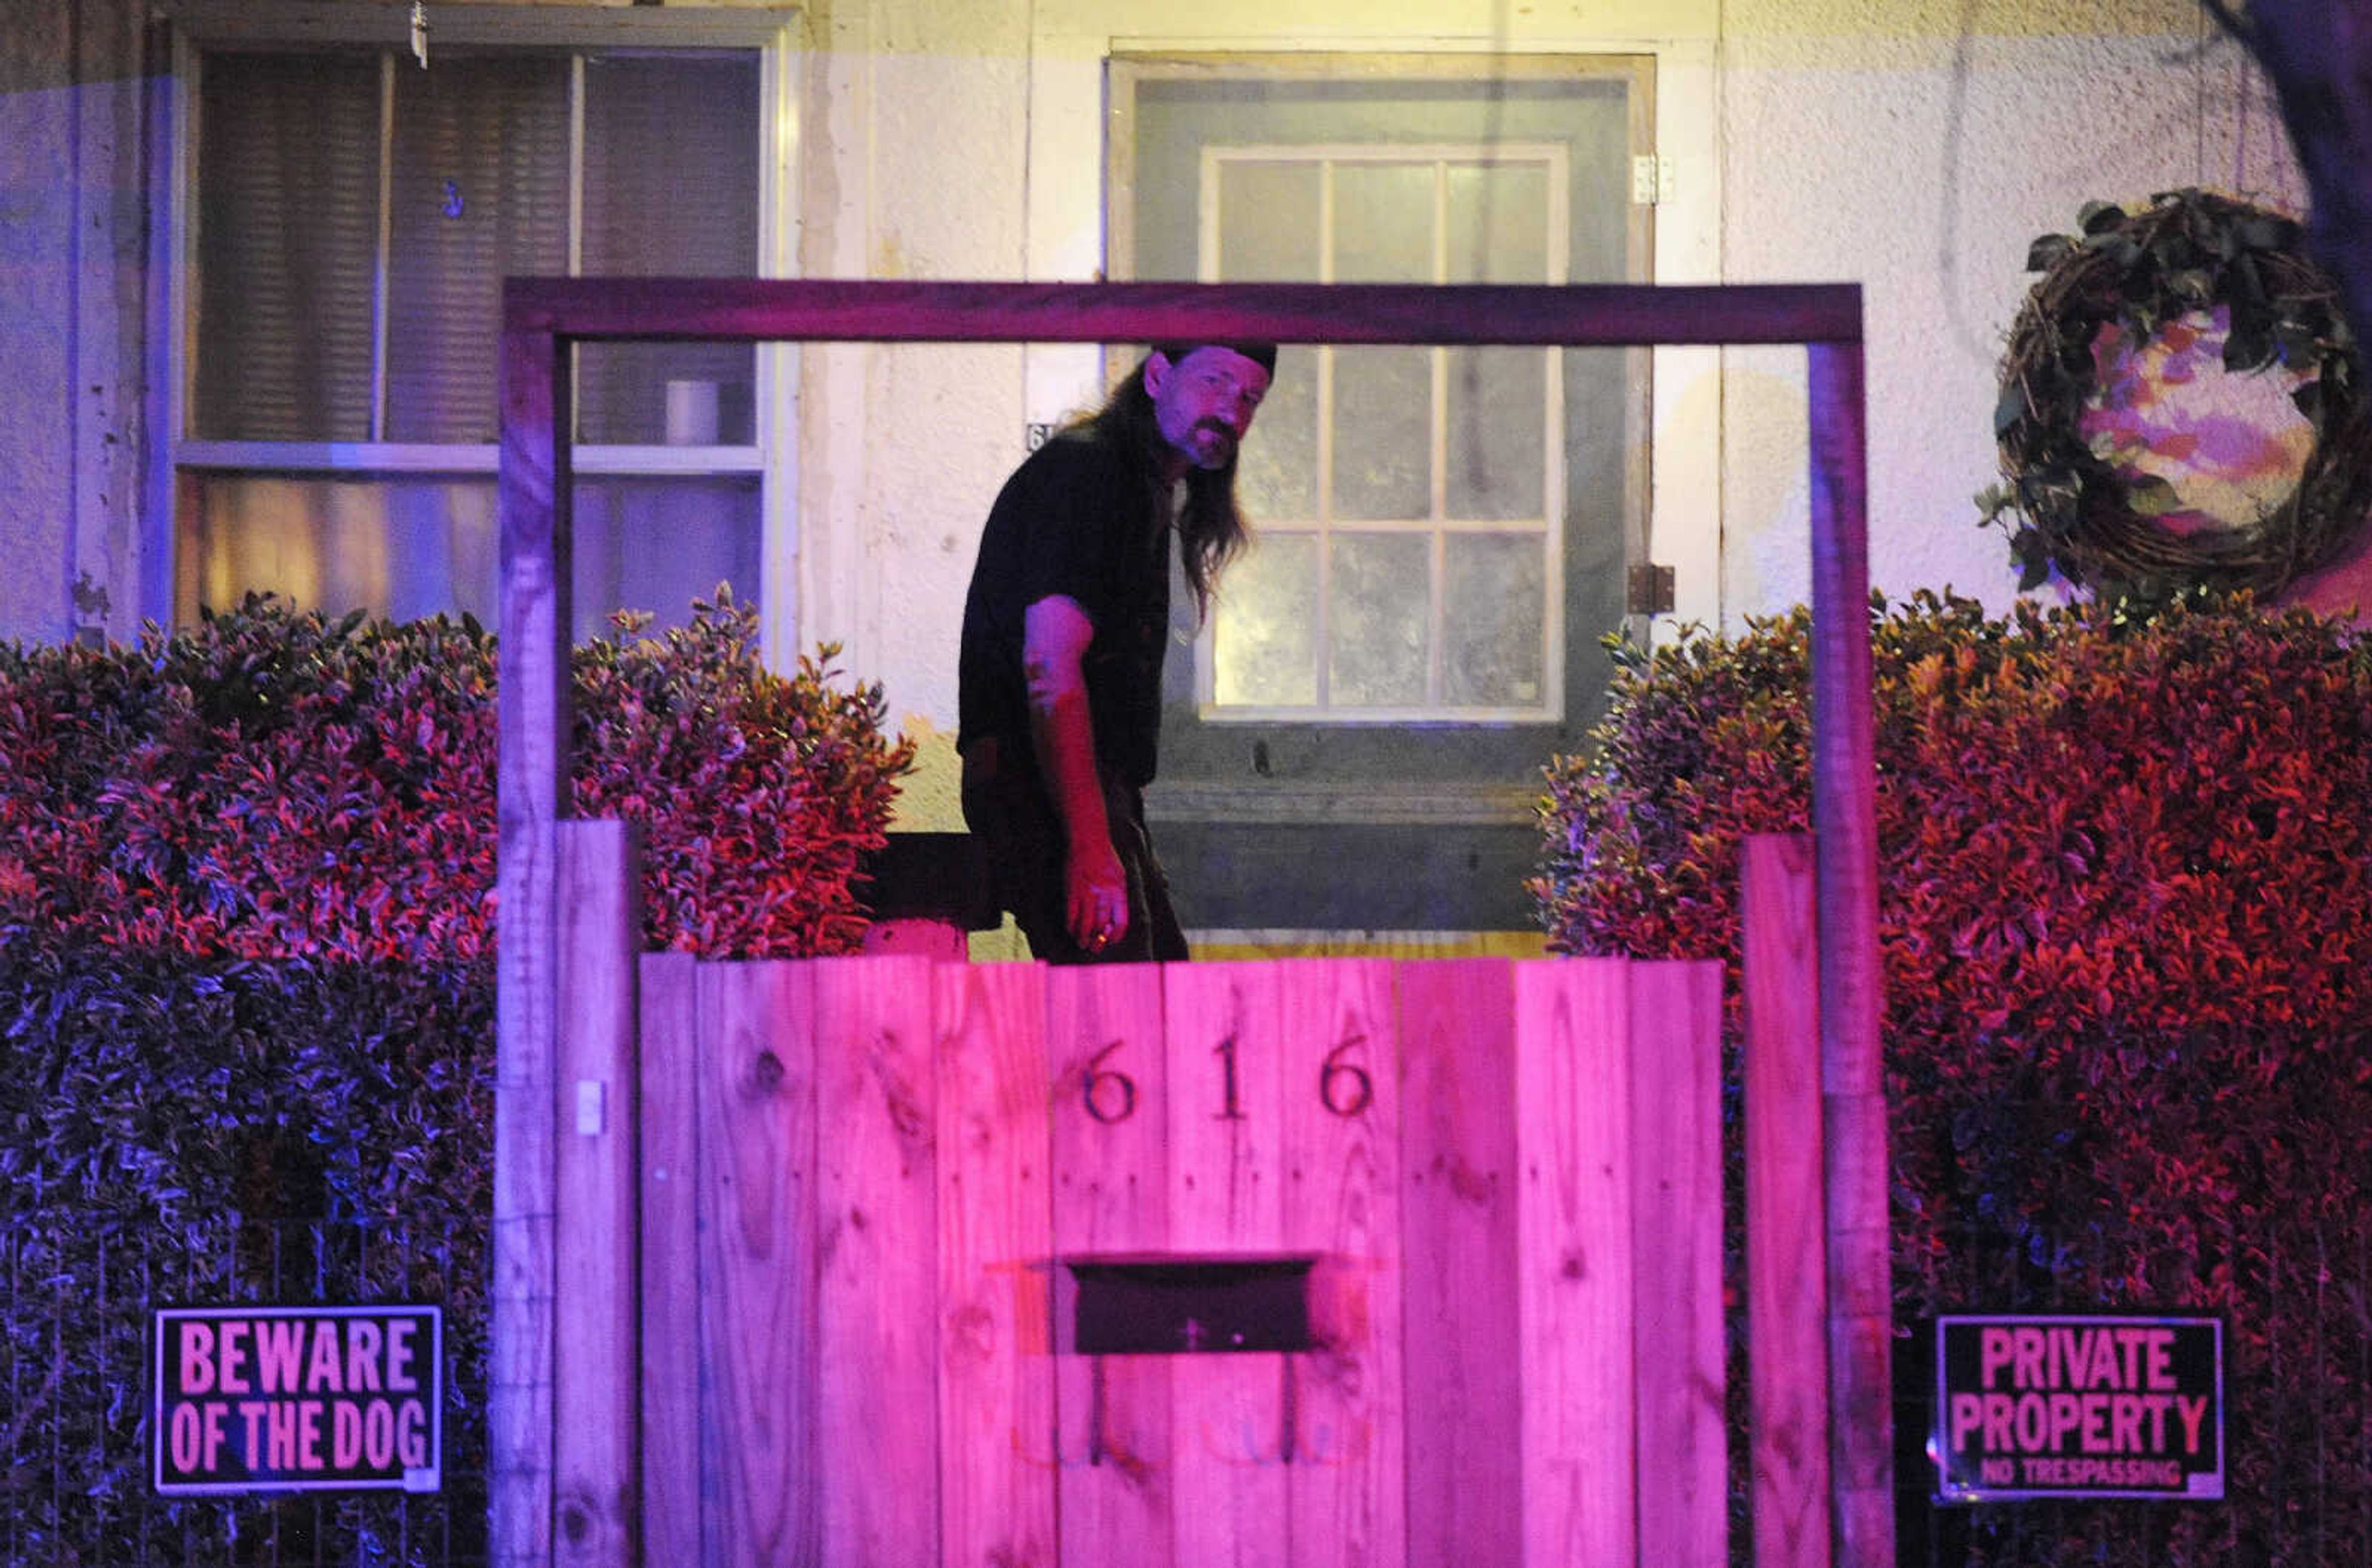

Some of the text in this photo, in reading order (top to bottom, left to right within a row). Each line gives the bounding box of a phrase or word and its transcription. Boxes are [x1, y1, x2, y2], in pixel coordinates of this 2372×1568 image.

[1083, 1031, 1373, 1126] 616
[180, 1319, 418, 1394] BEWARE
[1981, 1326, 2178, 1390] PRIVATE
[171, 1398, 426, 1474] OF THE DOG
[1951, 1392, 2208, 1455] PROPERTY
[1981, 1457, 2181, 1486] NO TRESPASSING
